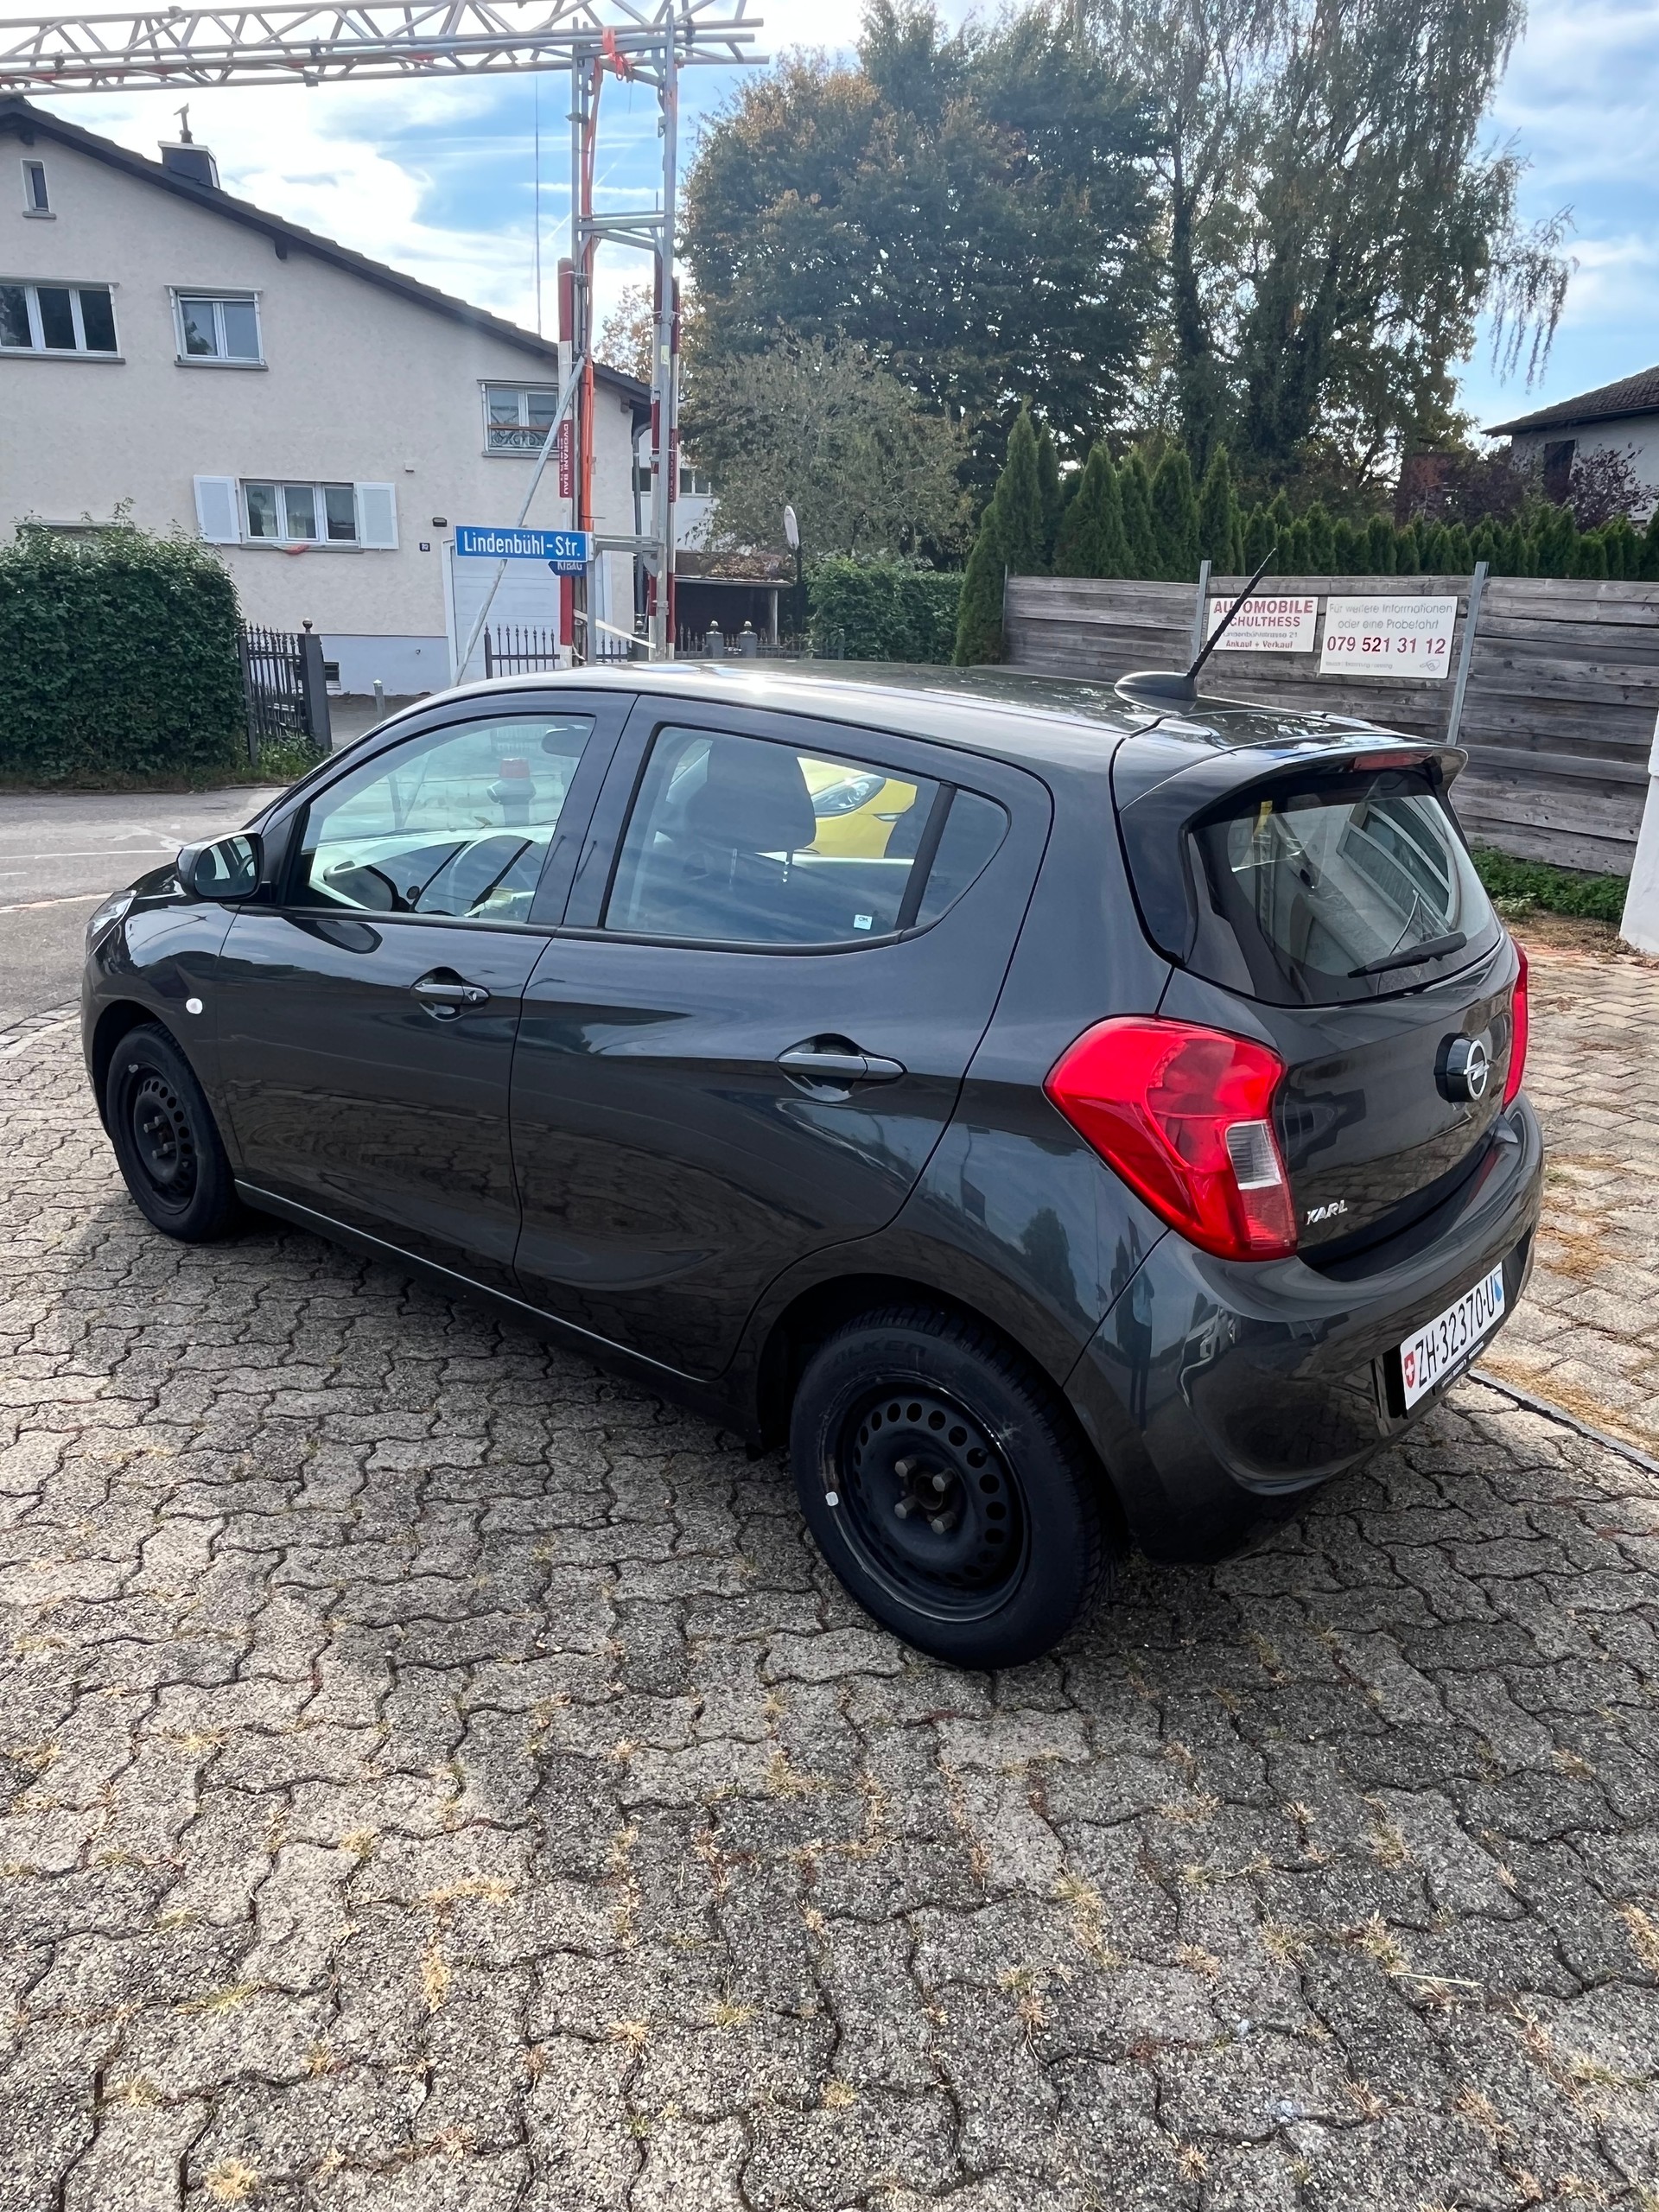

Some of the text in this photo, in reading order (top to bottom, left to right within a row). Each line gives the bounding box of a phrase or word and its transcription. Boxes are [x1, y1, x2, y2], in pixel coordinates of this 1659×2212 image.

[463, 531, 581, 556] Lindenbühl-Str.
[1213, 600, 1314, 614] AUOMOBILE
[1382, 602, 1452, 614] Informationen
[1223, 616, 1300, 627] CHULTHESS
[1338, 619, 1440, 630] oder eine Probefahrt
[1262, 640, 1294, 649] Verkauf
[1326, 635, 1446, 655] 079 521 31 12
[1306, 1199, 1348, 1225] KARL
